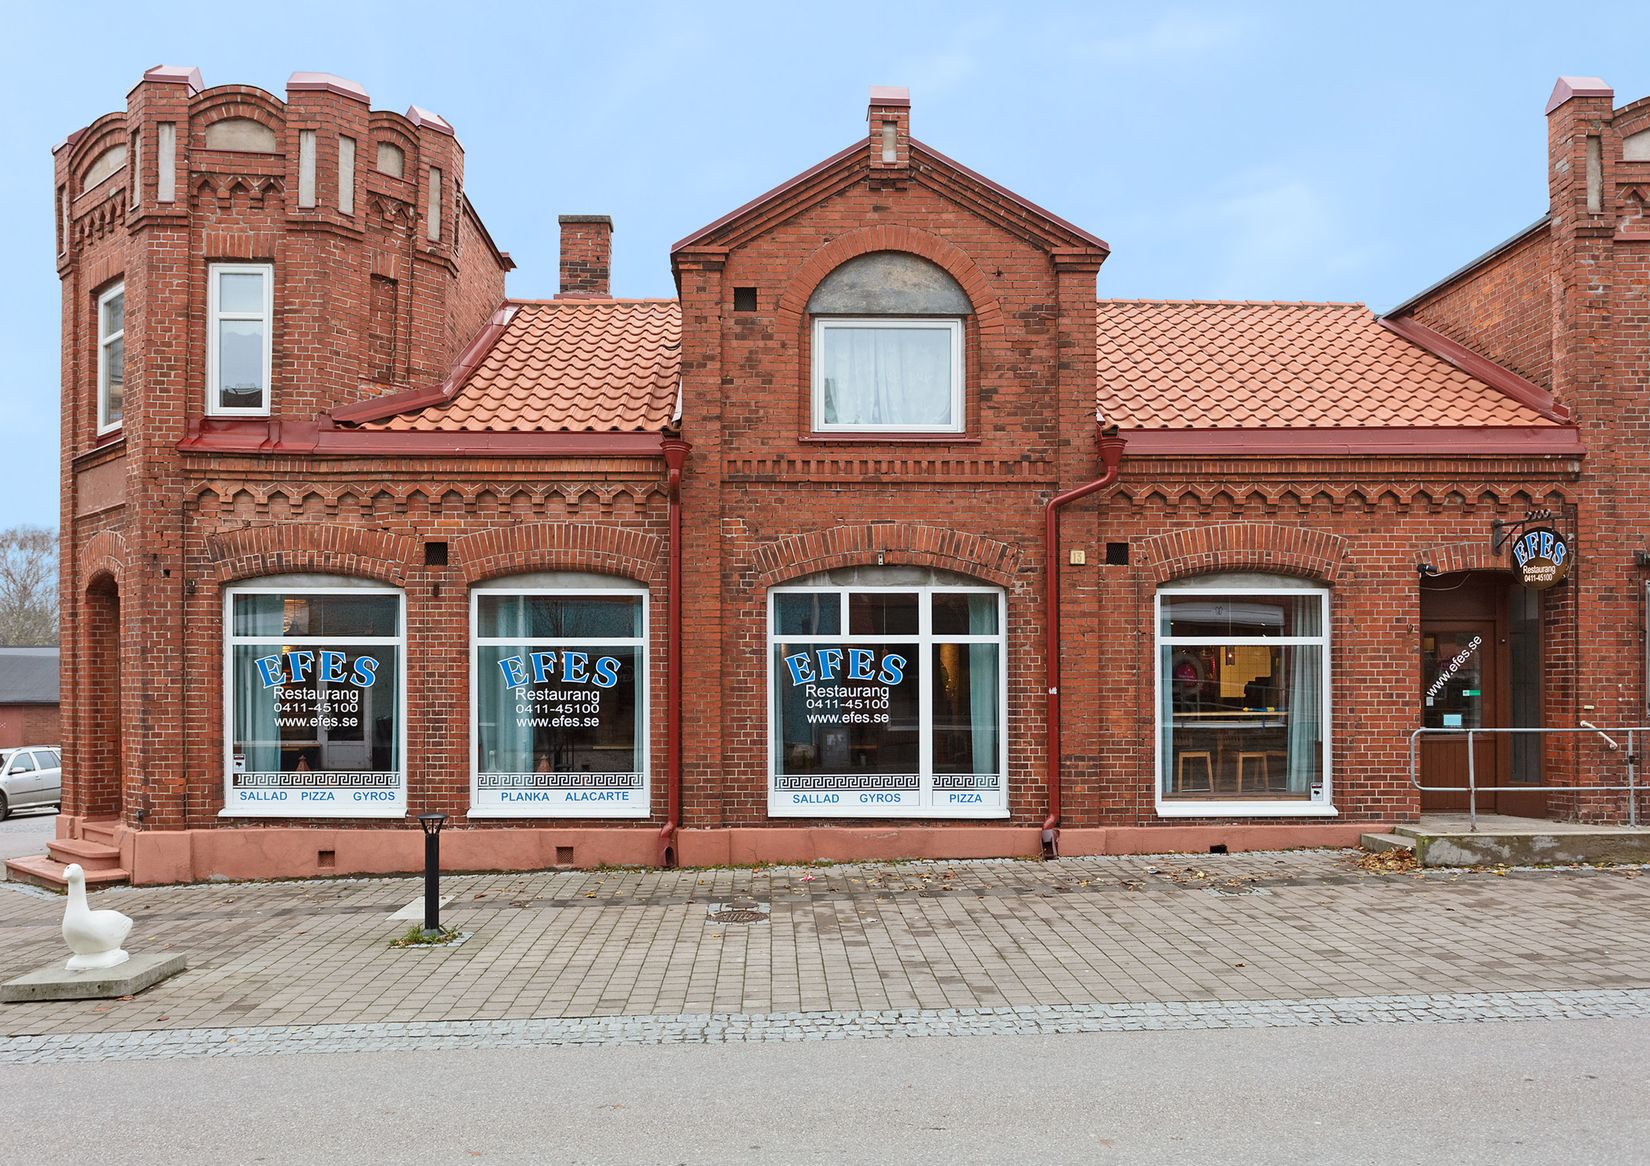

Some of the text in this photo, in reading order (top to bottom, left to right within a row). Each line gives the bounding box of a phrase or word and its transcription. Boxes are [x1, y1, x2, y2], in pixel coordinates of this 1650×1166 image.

[1513, 531, 1567, 568] EFES
[1523, 565, 1556, 575] Restaurang
[1524, 574, 1553, 582] 0411-45100
[254, 650, 380, 689] EFES
[497, 651, 622, 689] EFES
[784, 648, 908, 687] EFES
[1426, 635, 1482, 697] www.efes.se
[273, 687, 359, 702] Restaurang
[515, 687, 600, 703] Restaurang
[806, 685, 890, 699] Restaurang
[273, 702, 359, 713] 0411-45100
[515, 703, 600, 714] 0411-45100
[806, 699, 889, 709] 0411-45100
[274, 714, 359, 727] www.efes.se
[516, 715, 600, 728] www.efes.se
[806, 711, 889, 724] www.efes.se
[239, 791, 396, 801] SALLAD PIZZA GYROS
[501, 791, 630, 802] PLANKA ALACARTE
[792, 793, 982, 804] SALLAD GYROS PIZZA
